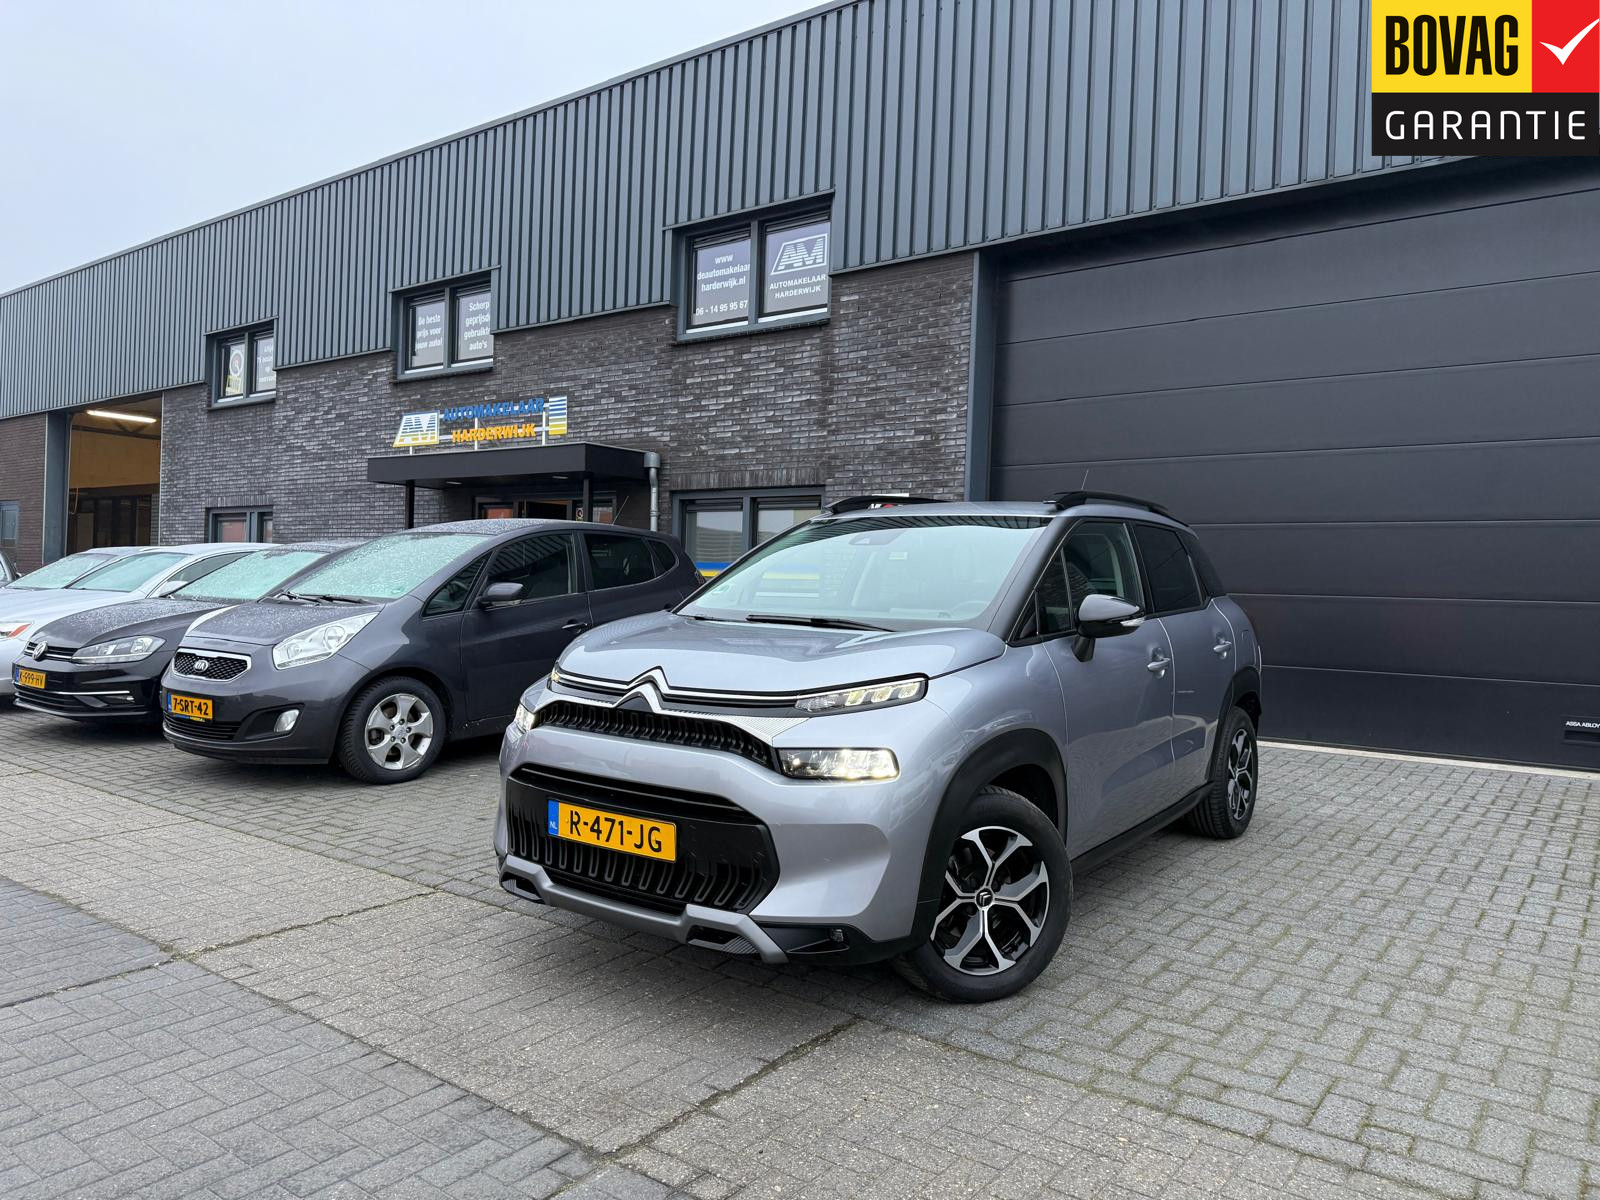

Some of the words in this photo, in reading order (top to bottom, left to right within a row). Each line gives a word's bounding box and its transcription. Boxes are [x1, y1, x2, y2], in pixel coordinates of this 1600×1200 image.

[714, 254, 733, 265] www
[697, 263, 751, 281] deautomakelaar
[701, 275, 746, 292] harderwijk.nl
[769, 274, 826, 290] AUTOMAKELAAR
[774, 285, 821, 299] HARDERWIJK
[469, 301, 490, 312] Scherp
[695, 307, 704, 316] 06
[710, 304, 718, 314] 14
[719, 303, 728, 312] 95
[729, 301, 738, 311] 95
[739, 299, 748, 309] 67
[465, 312, 491, 327] geprijsd
[469, 339, 488, 351] auto's
[442, 397, 545, 422] AUTOMAKELAAR
[451, 423, 536, 443] HARDERWIJK
[172, 697, 209, 716] 7-SRT-42
[550, 820, 558, 830] NL
[569, 809, 662, 853] R-471-JG
